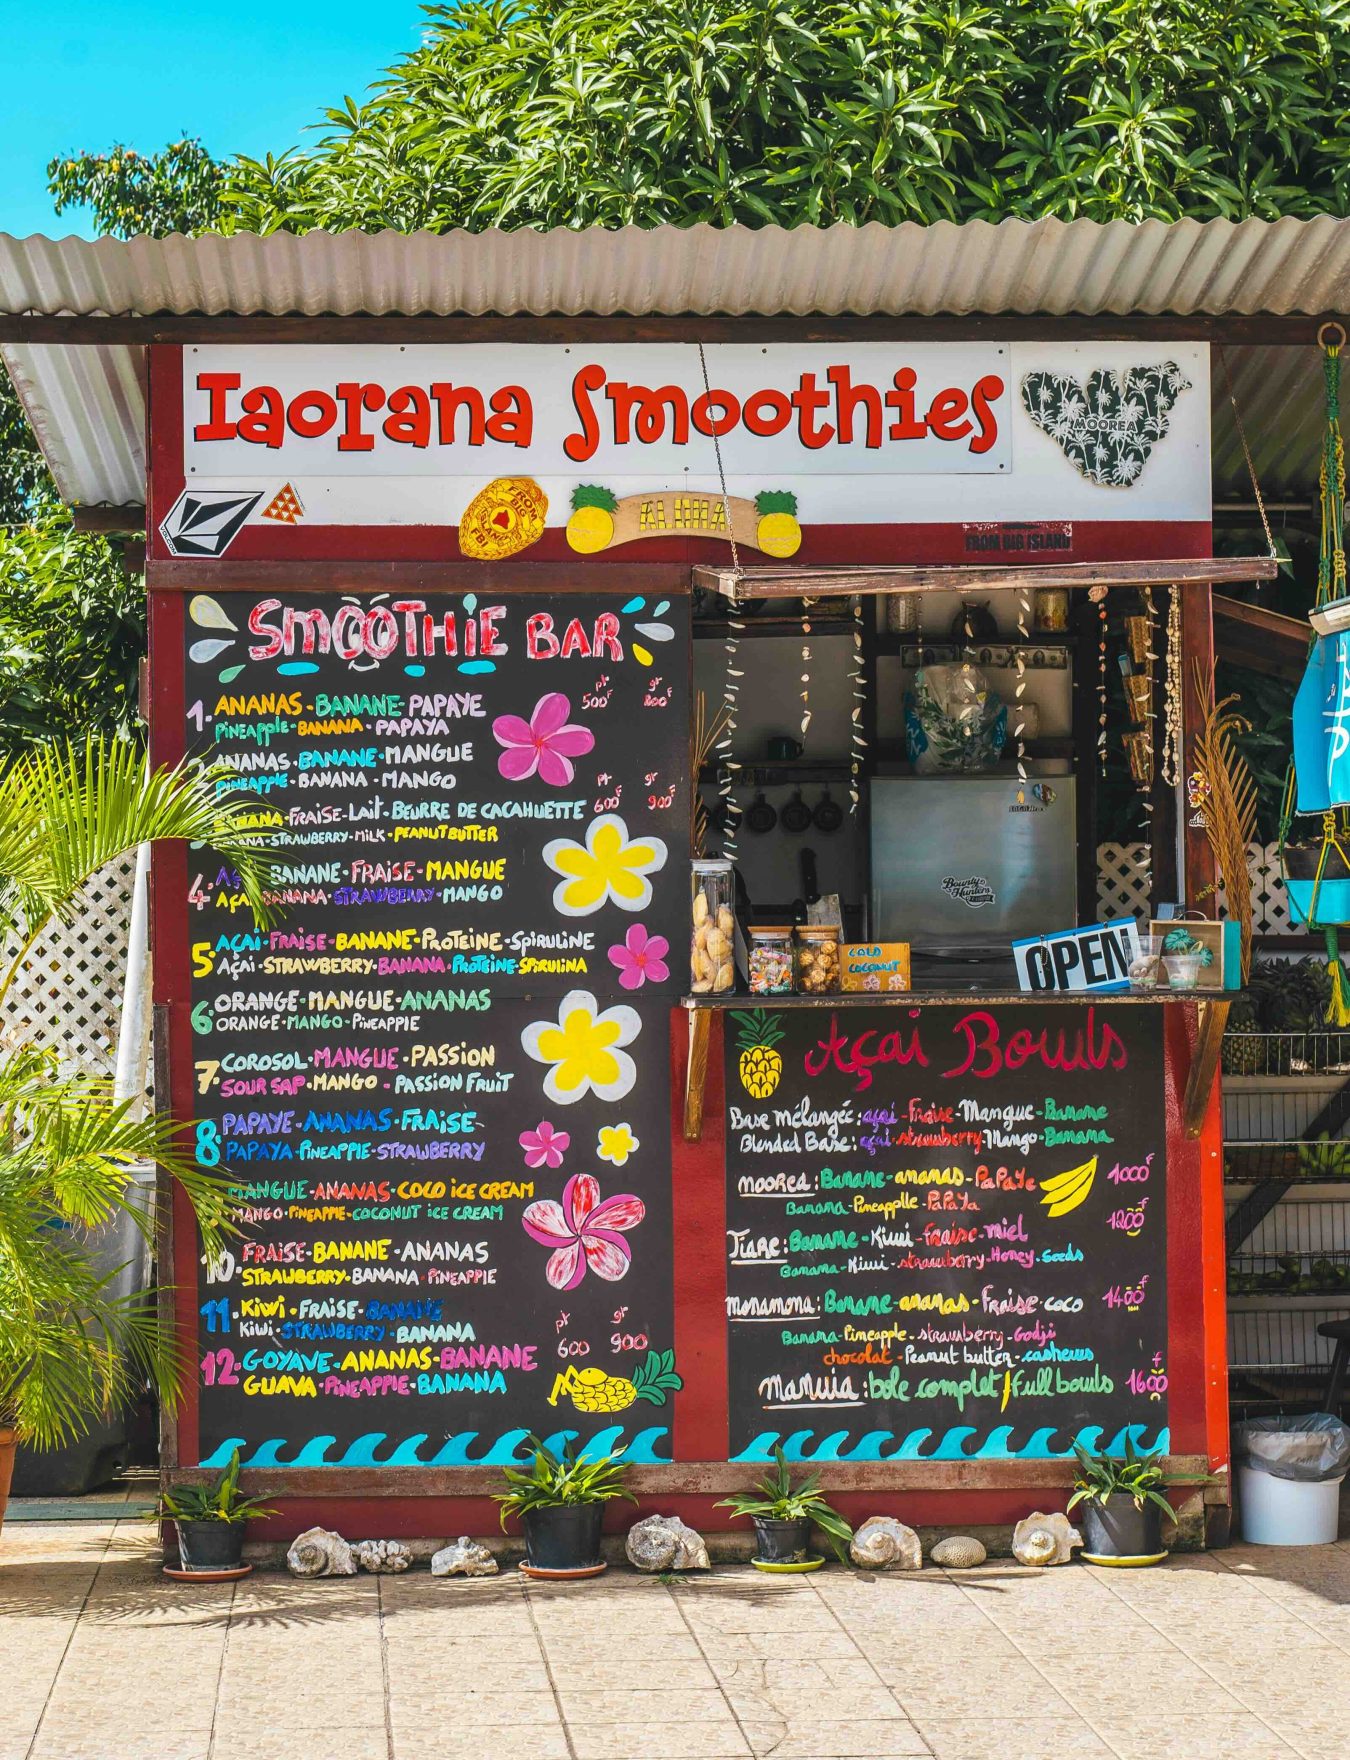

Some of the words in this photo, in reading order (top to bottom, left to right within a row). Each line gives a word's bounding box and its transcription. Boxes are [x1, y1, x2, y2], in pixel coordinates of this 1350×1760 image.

[193, 372, 533, 453] Iaorana
[563, 363, 1005, 463] Smoothies
[1073, 417, 1138, 433] MOOREA
[508, 486, 538, 521] FROM
[510, 498, 527, 518] BIG
[160, 526, 177, 555] VOLCOM
[471, 527, 489, 548] FBI
[526, 612, 624, 662] BAR
[214, 691, 302, 716] ANANAS
[315, 693, 401, 717] BANANE
[408, 692, 487, 718] PAPAYE
[298, 718, 363, 736] BANANA
[375, 717, 450, 738] PAPAYA
[214, 751, 291, 773] ANANAS
[299, 747, 377, 770] BANANE
[385, 742, 474, 765] MANGUE
[299, 771, 368, 788] BANANA
[382, 771, 457, 789] MANGO
[391, 800, 450, 822] BEURRE
[458, 802, 478, 820] DE
[481, 800, 588, 820] CACAHUETTE
[270, 831, 349, 847] STRAWBERRY
[394, 824, 448, 843] PEANUT
[449, 824, 499, 842] BUTTER
[270, 861, 341, 885] BANANE
[426, 858, 507, 882] MANGUE
[261, 887, 328, 906] BANANA
[334, 887, 435, 906] STRAWBERRY
[443, 885, 503, 904] MANGO
[336, 928, 417, 952] BANANE
[848, 946, 882, 958] COLD
[1025, 928, 1129, 991] OPEN
[263, 955, 373, 975] STRAWBERRY
[377, 955, 445, 976] BANANA
[848, 960, 901, 973] COCONUT
[214, 989, 300, 1013] ORANGE
[308, 989, 395, 1012] MANGUE
[400, 988, 492, 1012] ANANAS
[216, 1013, 281, 1032] ORANGE
[287, 1013, 343, 1031] MANGO
[221, 1051, 308, 1073] COROSOL
[313, 1046, 399, 1070] MANGUE
[219, 1077, 267, 1097] SOUR
[270, 1074, 305, 1095] SAP
[313, 1072, 378, 1092] MANGO
[222, 1110, 296, 1136] PAPAYE
[303, 1108, 393, 1134] ANANAS
[226, 1140, 294, 1161] PAPAYA
[377, 1140, 486, 1161] STRAWBERRY
[227, 1180, 309, 1200] MANGUE
[313, 1180, 391, 1203] ANANAS
[397, 1180, 446, 1199] COCO
[478, 1181, 535, 1199] CREAM
[232, 1206, 284, 1224] MANGO
[352, 1204, 422, 1221] COCONUT
[453, 1204, 504, 1221] CREAM
[313, 1238, 392, 1264] BANANE
[400, 1240, 489, 1264] ANANAS
[241, 1267, 346, 1287] STRAWBERRY
[351, 1267, 419, 1286] BANANA
[366, 1297, 444, 1321] BANANE
[280, 1321, 386, 1342] STRAWBERRY
[396, 1322, 476, 1344] BANANA
[557, 1337, 590, 1359] 600
[610, 1332, 648, 1354] 900
[823, 1343, 893, 1366] chocolat
[242, 1348, 334, 1374] GOYAVE
[341, 1346, 433, 1373] ANANAS
[440, 1343, 538, 1371] BANANE
[243, 1375, 318, 1398] GUAVA
[417, 1370, 507, 1395] BANANA
